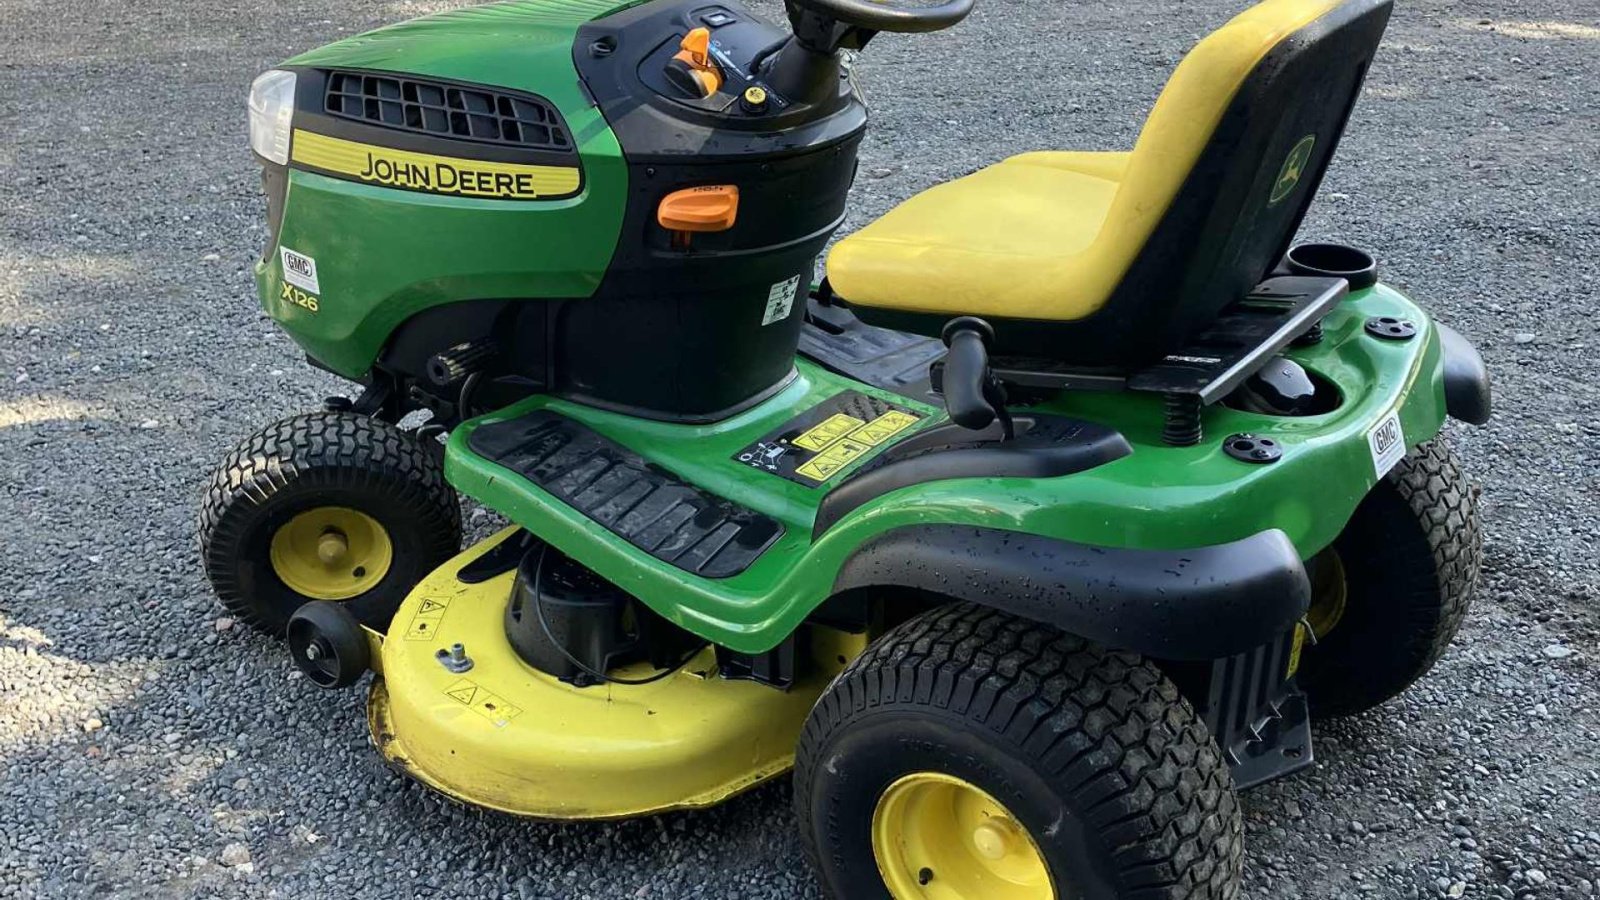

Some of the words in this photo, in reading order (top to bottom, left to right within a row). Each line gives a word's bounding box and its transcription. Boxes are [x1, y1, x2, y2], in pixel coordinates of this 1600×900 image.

[361, 152, 431, 187] JOHN
[436, 163, 535, 195] DEERE
[287, 254, 310, 275] GMC
[282, 281, 319, 312] X126
[1375, 421, 1397, 451] GMC
